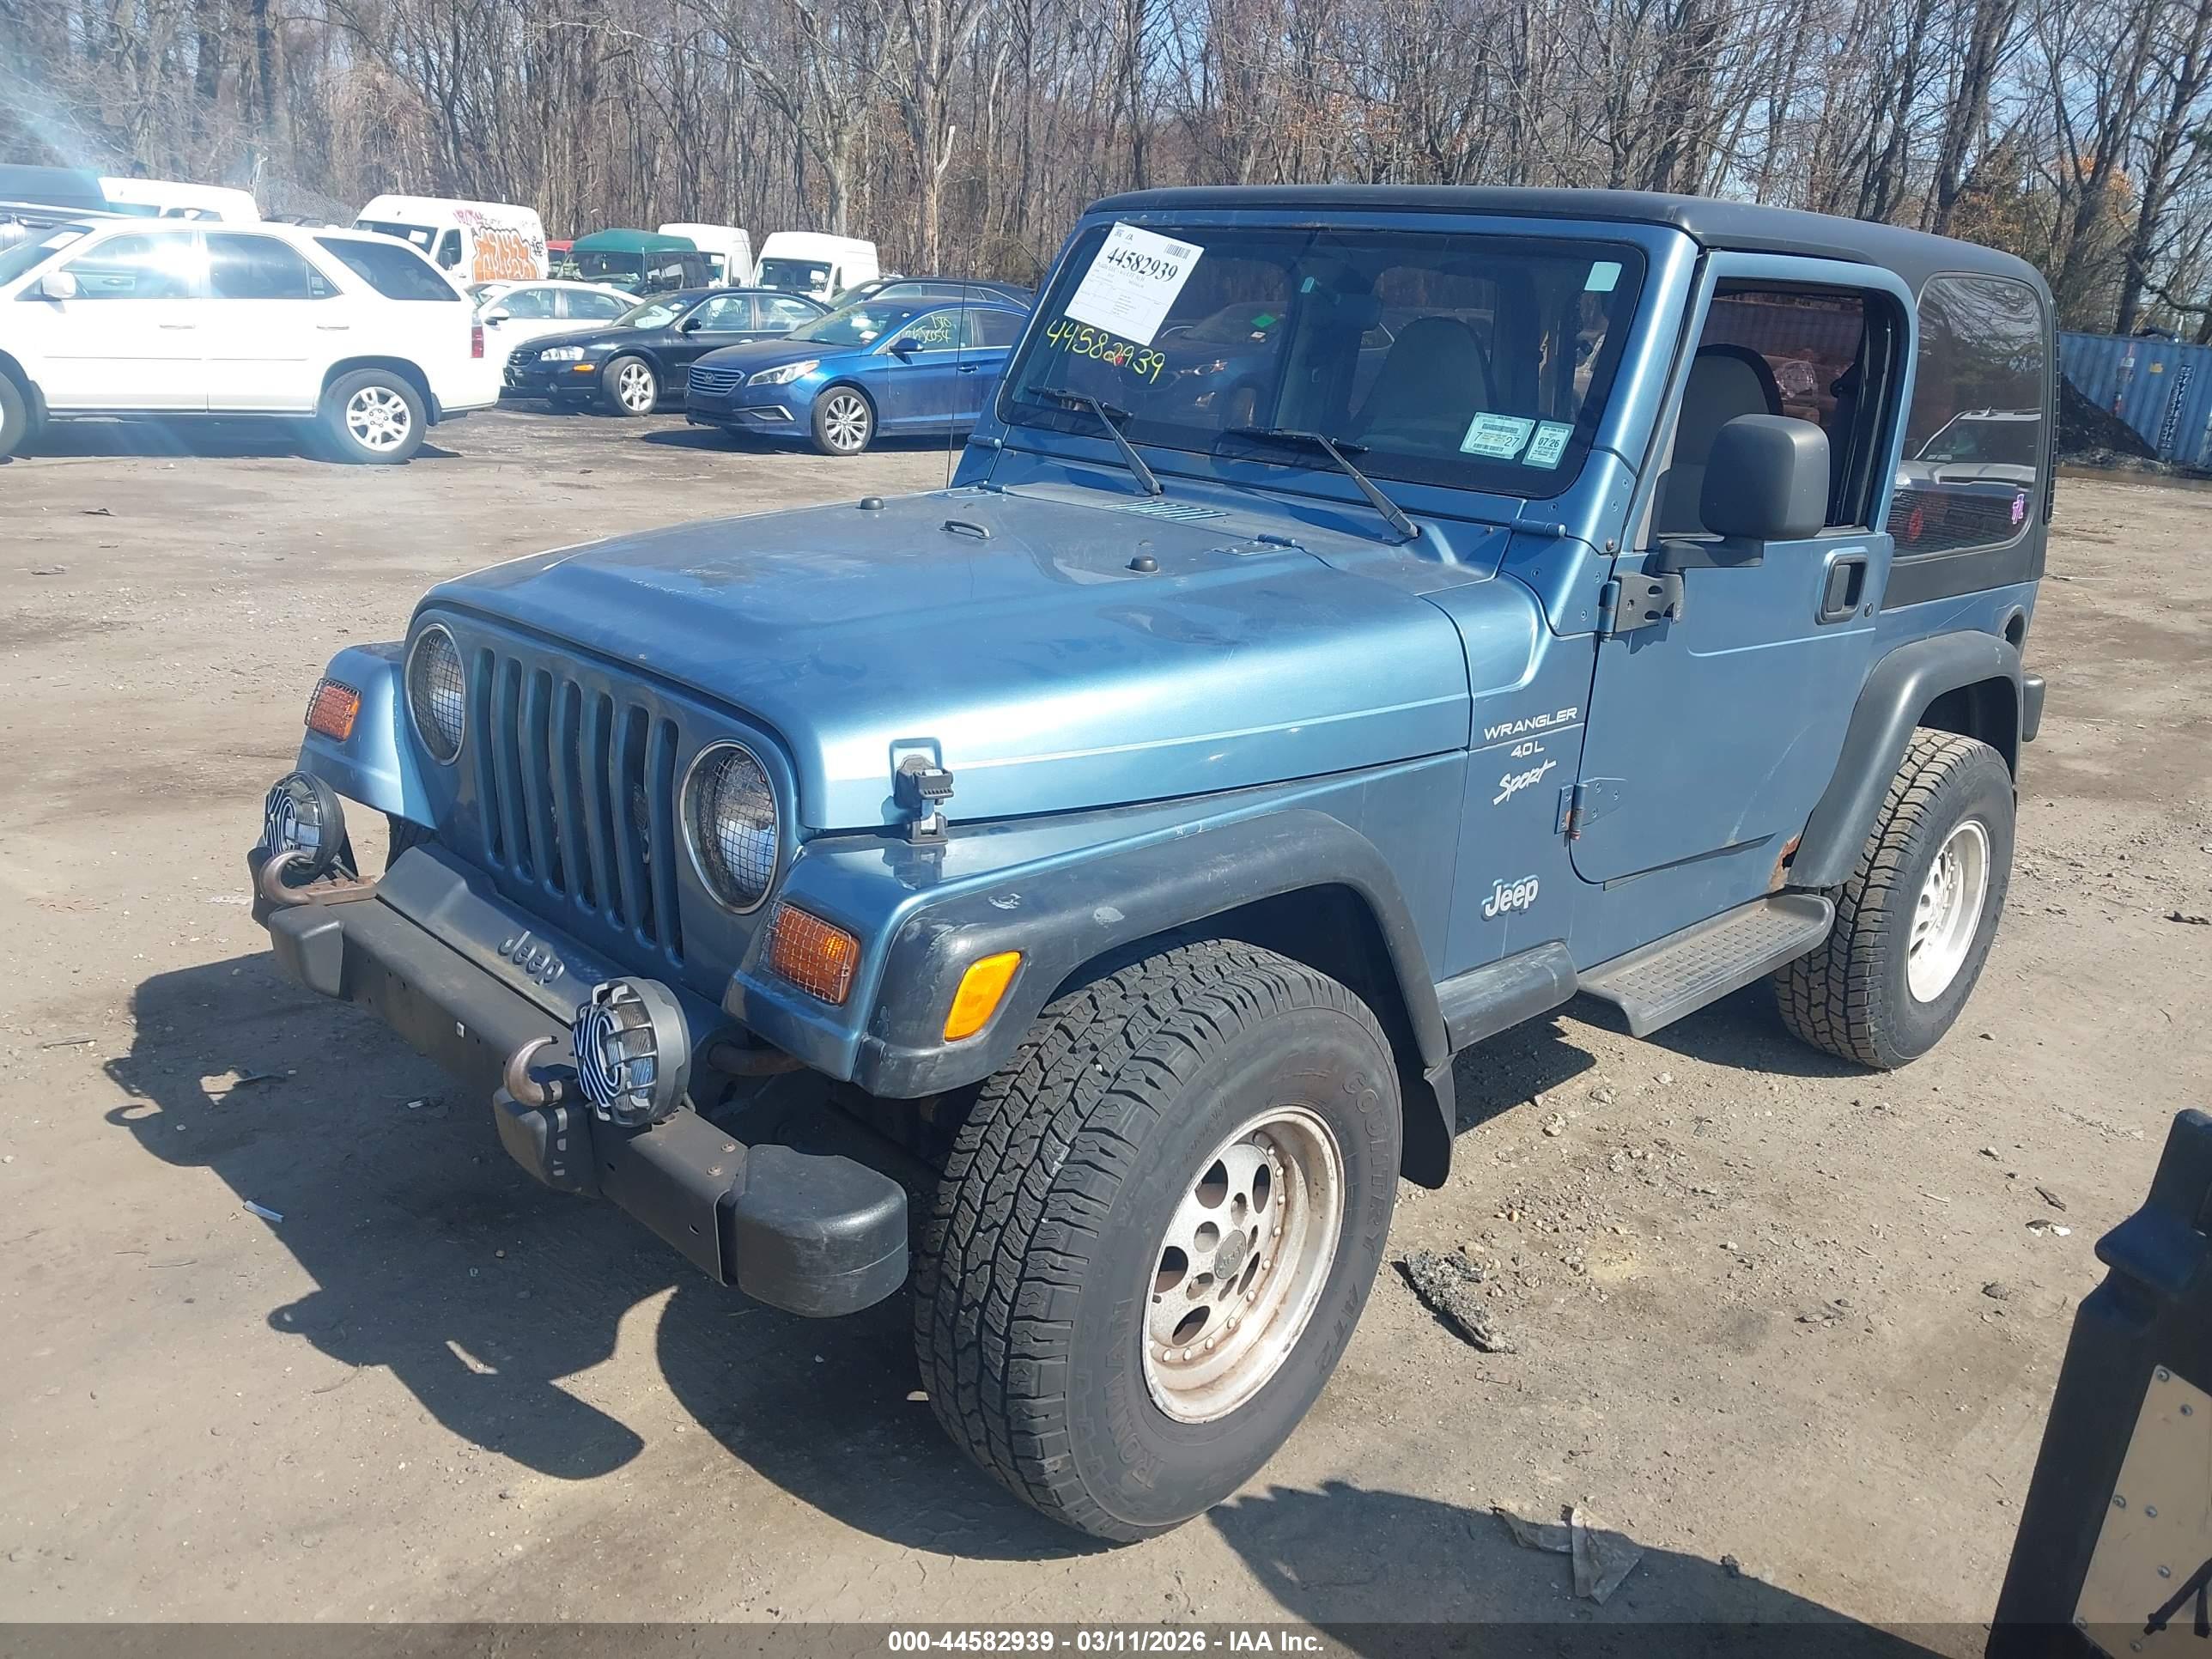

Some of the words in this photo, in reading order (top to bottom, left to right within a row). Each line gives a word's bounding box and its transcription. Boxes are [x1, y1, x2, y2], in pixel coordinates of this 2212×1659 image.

[1107, 246, 1179, 283] 44582939
[1047, 319, 1166, 385] 44582939
[1504, 436, 1521, 447] 27
[1483, 707, 1578, 741] WRANGLER
[1482, 876, 1539, 919] Jeep
[497, 930, 566, 986] Jeep
[1341, 1070, 1389, 1261] COUNTRY
[1104, 1297, 1166, 1491] IRONMAN
